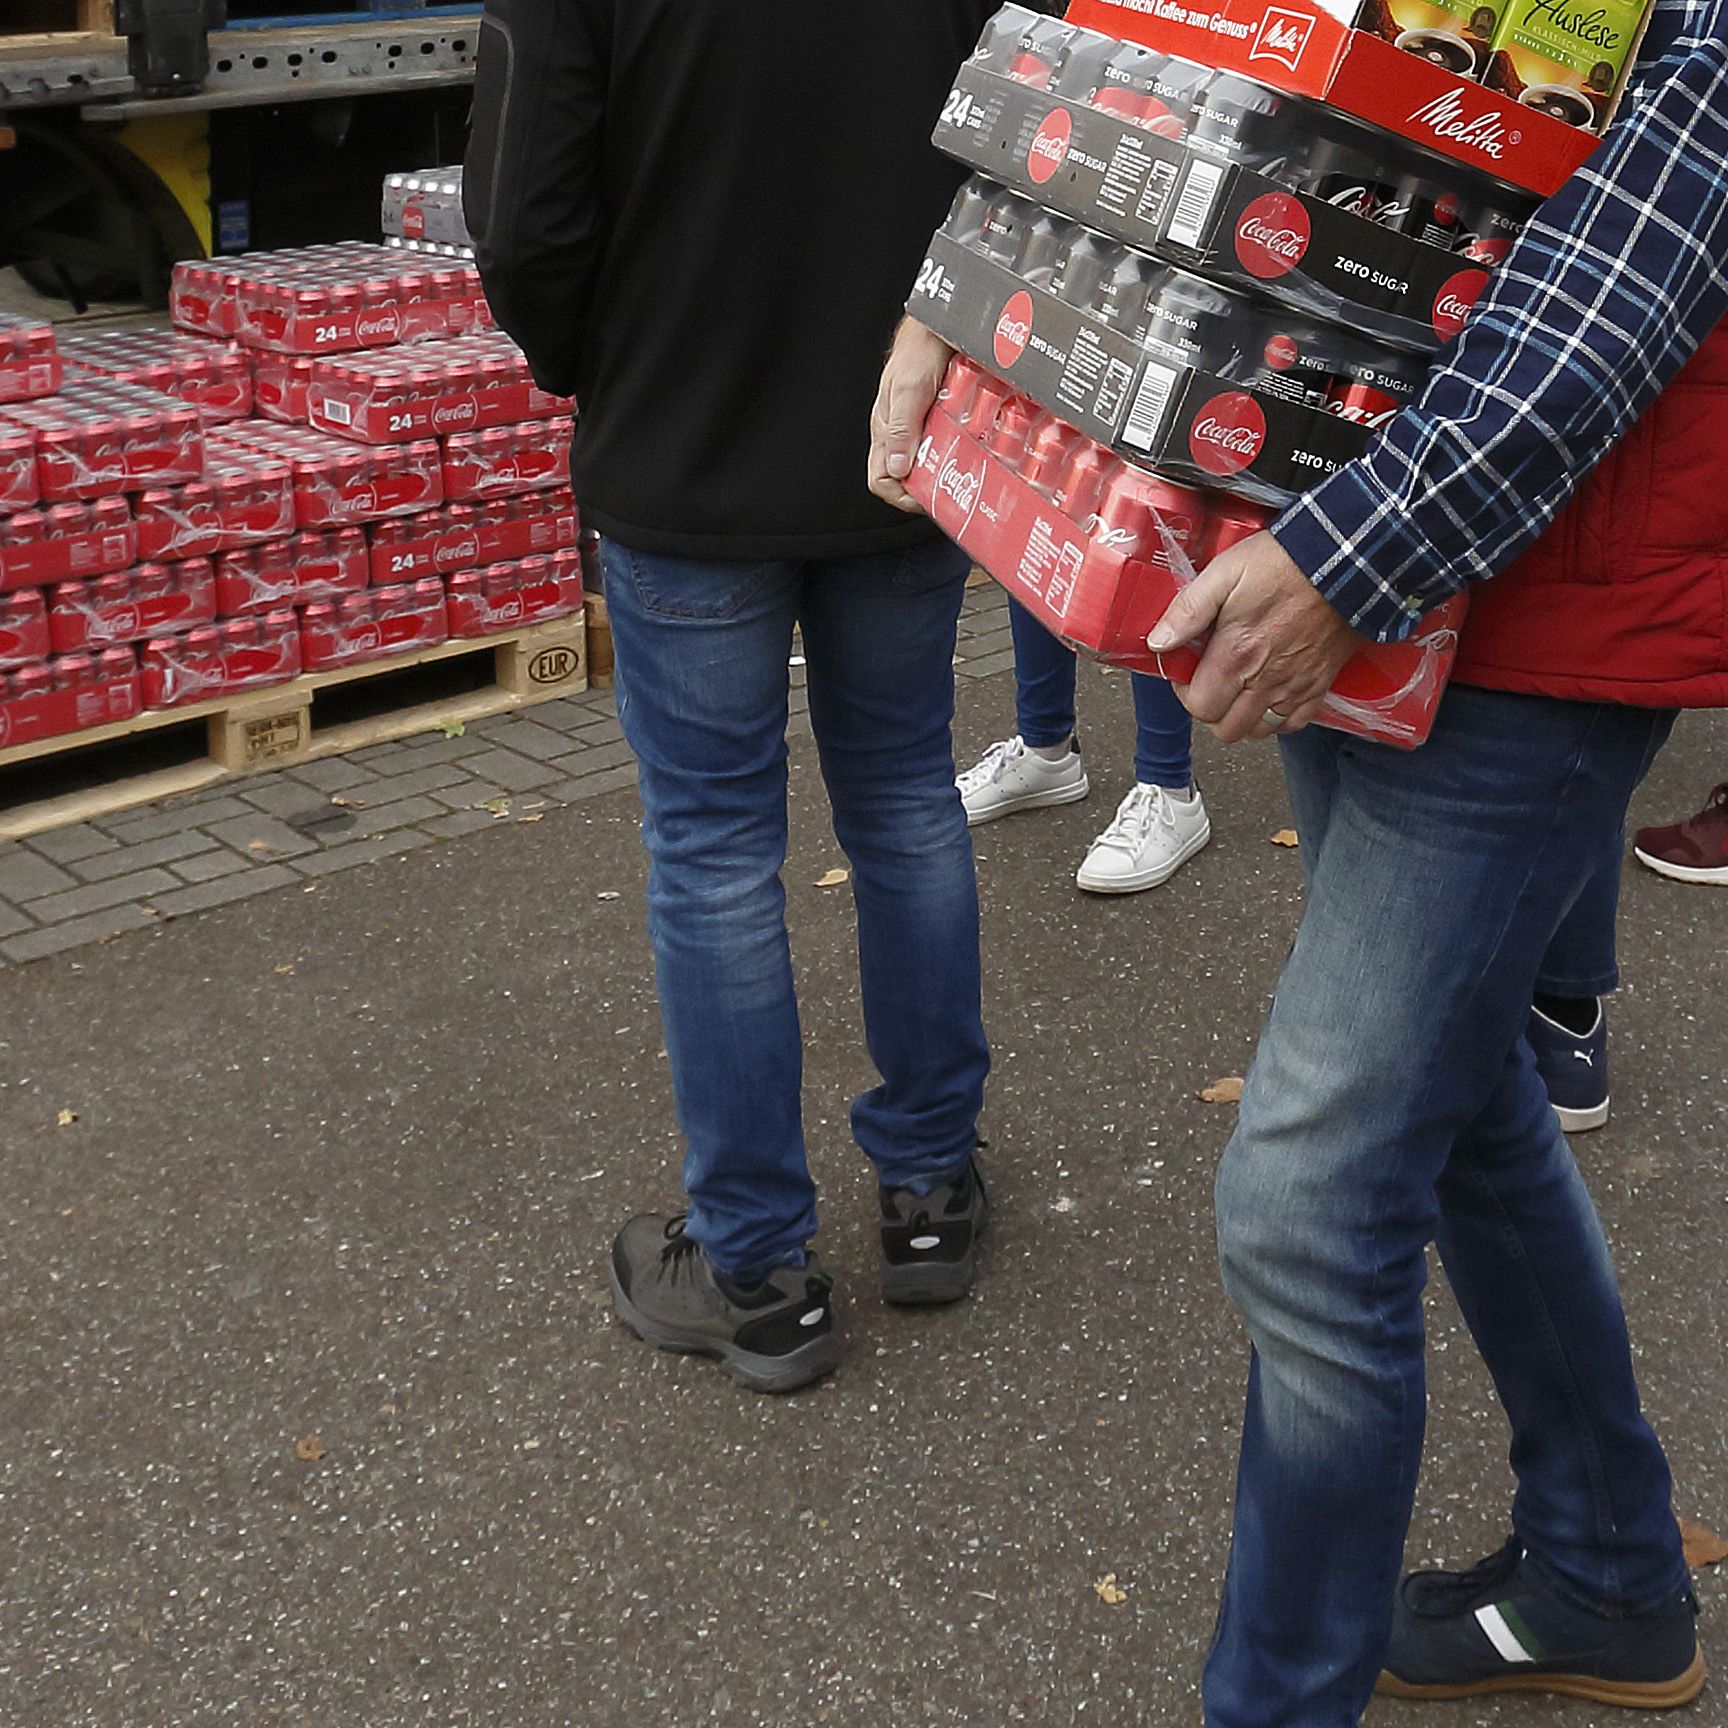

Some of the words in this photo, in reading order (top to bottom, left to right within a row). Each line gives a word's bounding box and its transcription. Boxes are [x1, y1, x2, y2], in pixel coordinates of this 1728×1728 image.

[1153, 0, 1185, 23] Kaffee
[1209, 15, 1249, 40] Genuss
[940, 89, 974, 129] 24
[1205, 108, 1239, 128] SUGAR
[1406, 87, 1504, 159] Melitta
[1239, 217, 1305, 260] Coca-Cola
[915, 258, 945, 300] 24
[1334, 254, 1370, 279] zero
[1370, 269, 1410, 295] SUGAR
[315, 325, 337, 343] 24
[1163, 309, 1198, 332] SUGAR
[389, 413, 412, 432] 24
[1193, 417, 1260, 455] Coca-Cola
[1291, 448, 1323, 470] zero
[939, 458, 980, 514] Coca-Cola
[391, 552, 414, 571] 24
[538, 654, 569, 679] EUR
